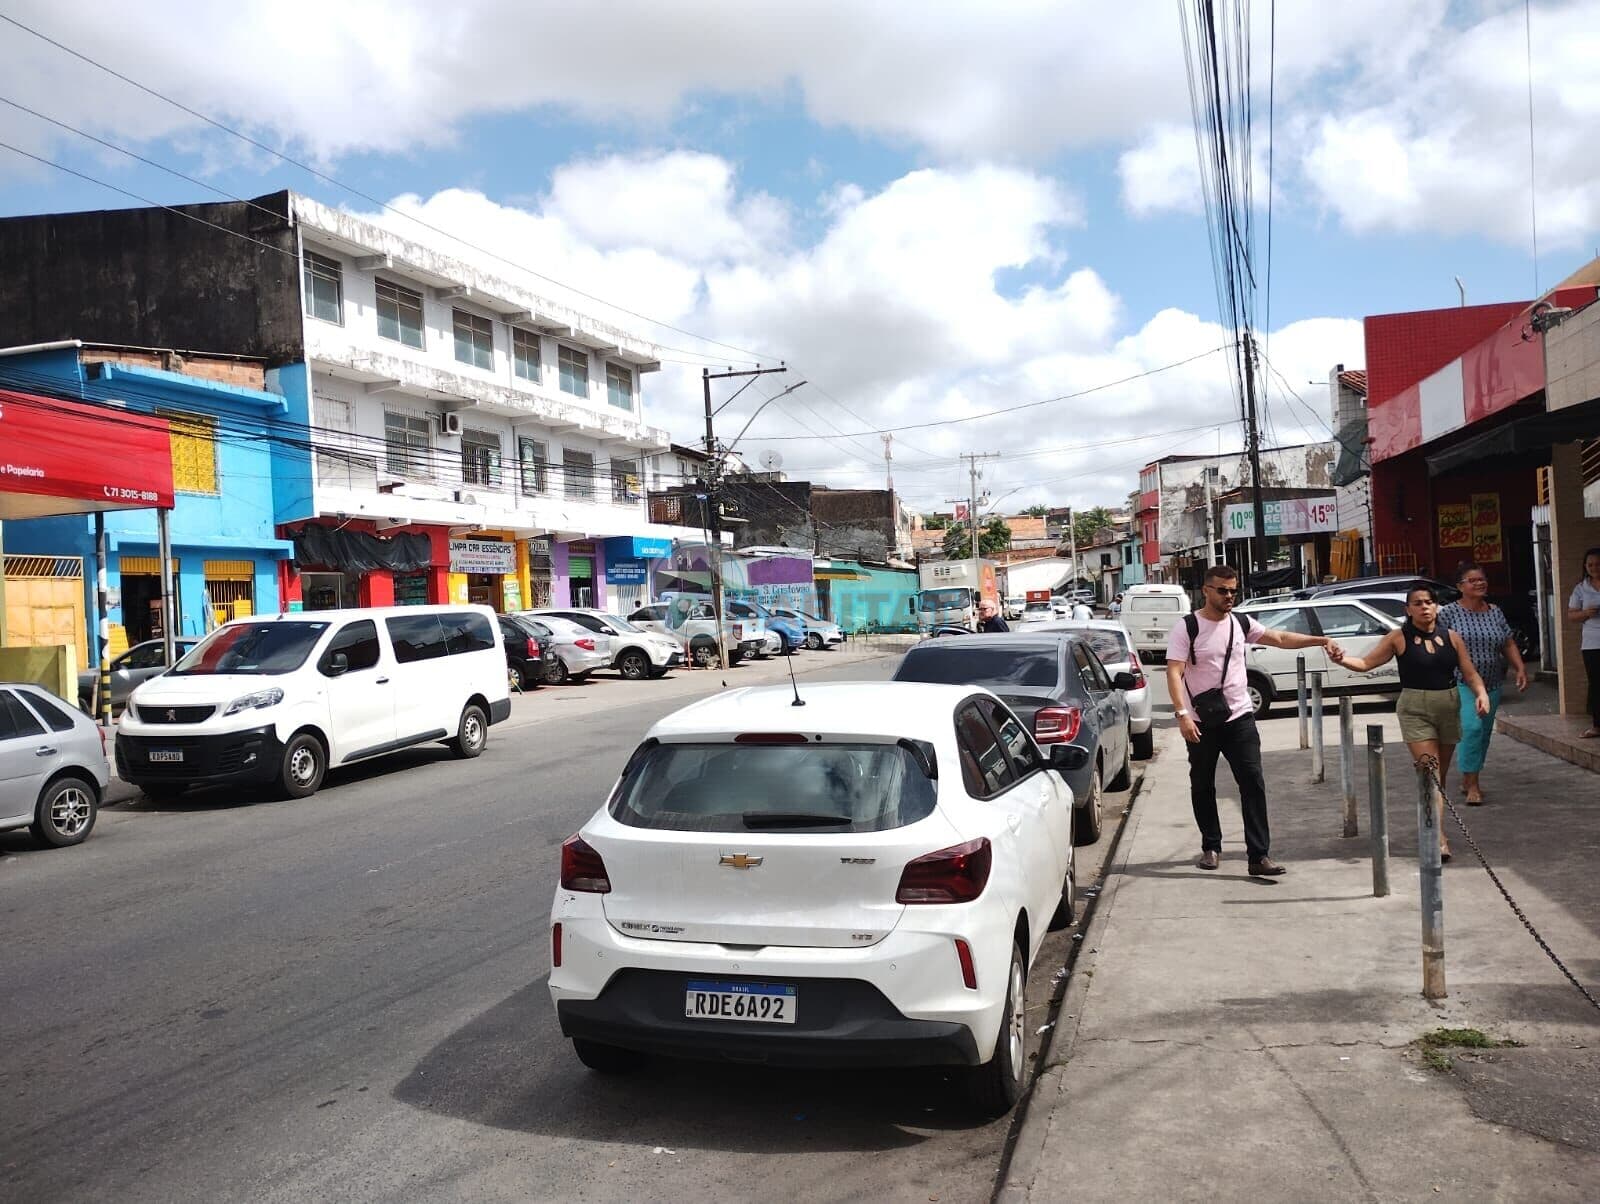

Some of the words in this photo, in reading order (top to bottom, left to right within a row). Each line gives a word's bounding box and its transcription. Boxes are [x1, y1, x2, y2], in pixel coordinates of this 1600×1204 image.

[6, 464, 45, 477] Papelaria
[110, 487, 119, 497] 71
[695, 993, 785, 1019] RDE6A92
